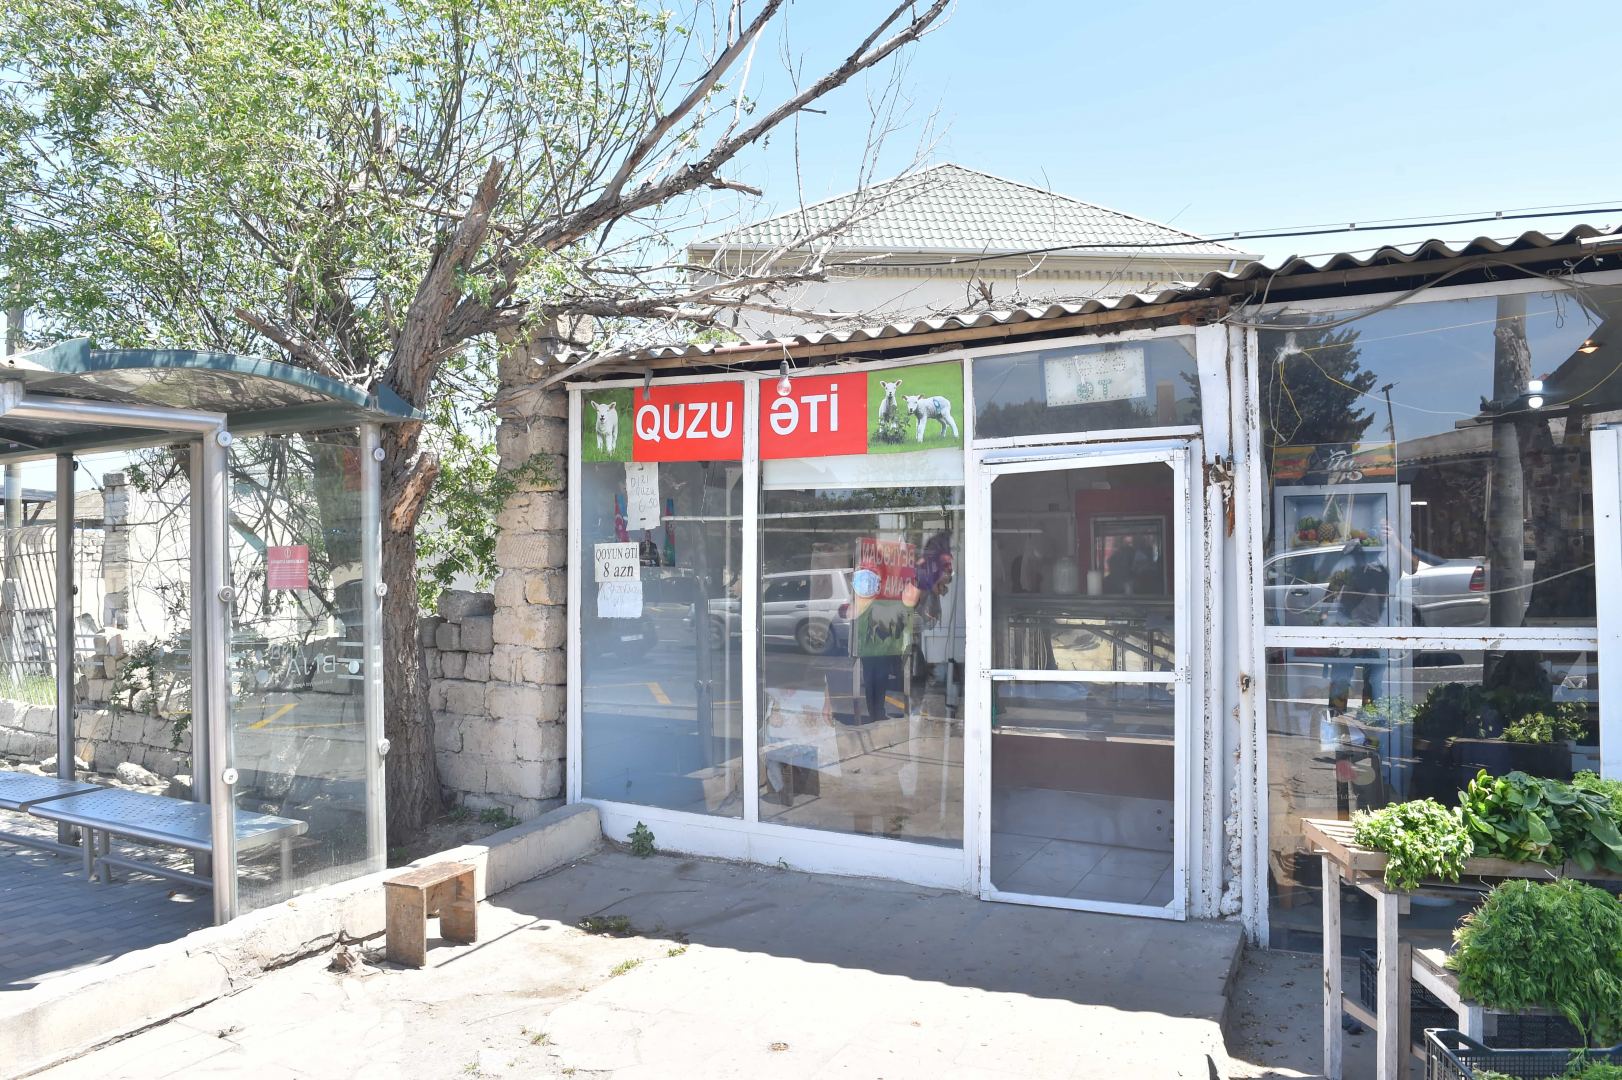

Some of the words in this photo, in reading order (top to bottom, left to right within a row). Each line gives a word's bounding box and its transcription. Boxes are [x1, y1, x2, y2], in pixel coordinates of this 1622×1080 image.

[636, 402, 733, 443] QUZU
[770, 384, 838, 435] ƏTİ
[603, 561, 611, 578] 8
[613, 566, 634, 578] azn
